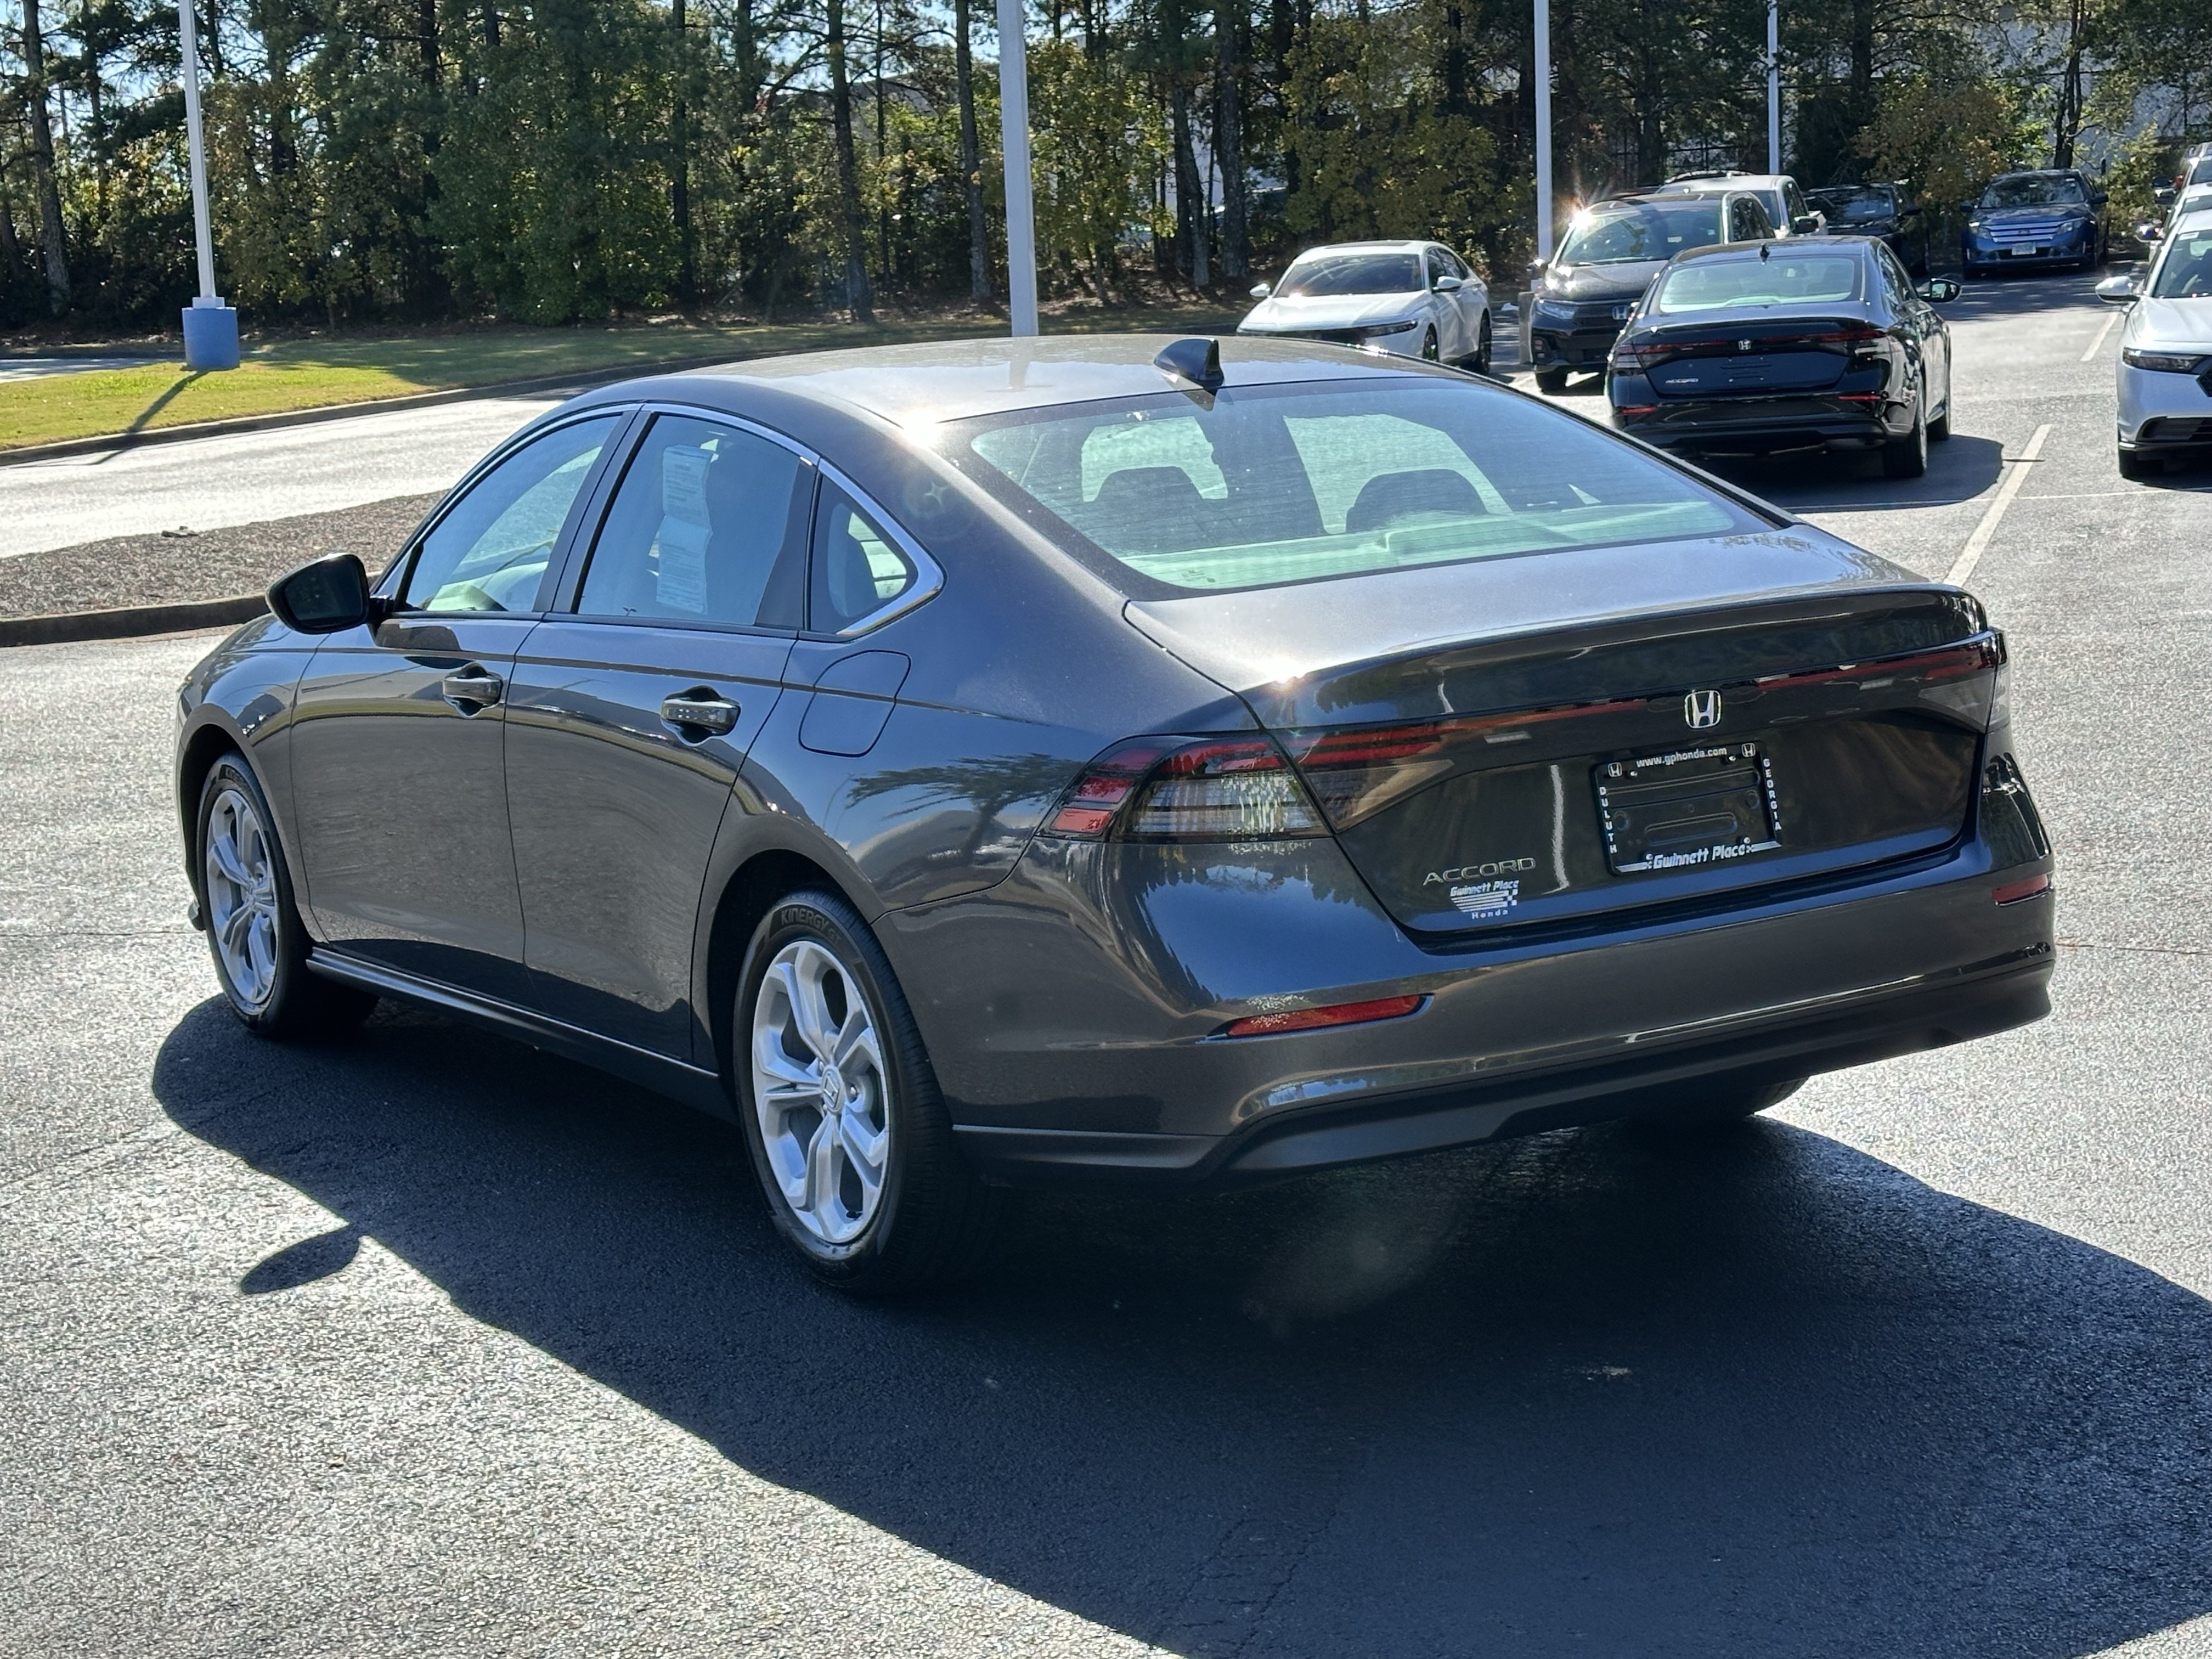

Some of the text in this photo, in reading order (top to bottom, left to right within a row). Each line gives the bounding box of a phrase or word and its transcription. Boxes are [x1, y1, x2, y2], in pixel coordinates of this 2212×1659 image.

[1636, 747, 1728, 768] www.gphonda.com
[1763, 758, 1782, 831] GEORGIA
[1599, 786, 1618, 854] DULUTH
[1653, 844, 1746, 870] Gwinnett Place
[1423, 857, 1536, 886] ACCORD
[1449, 880, 1520, 897] Gwinnett Place
[781, 907, 830, 932] KINERGY
[1471, 909, 1509, 919] Honda
